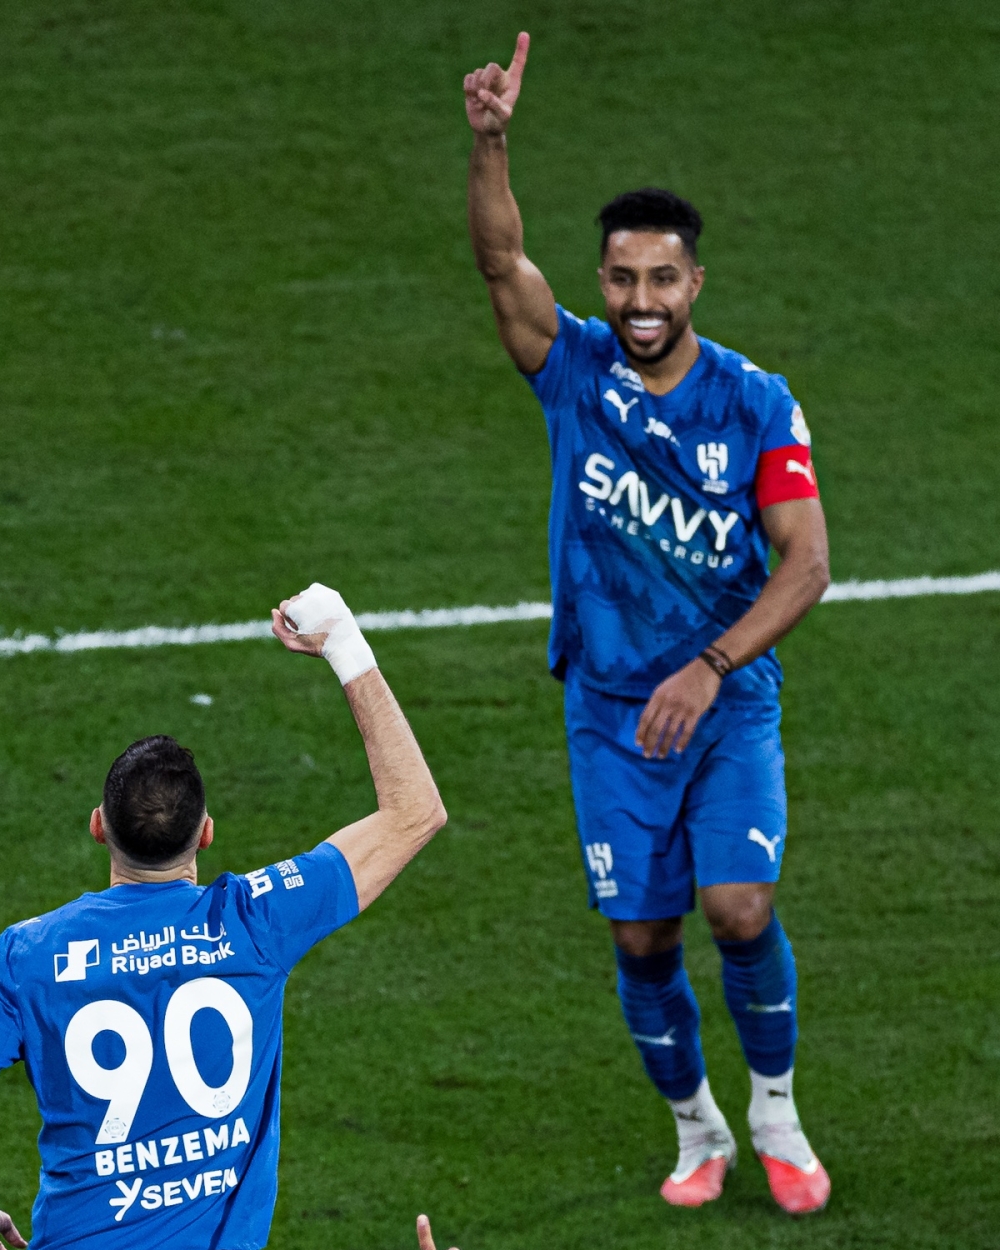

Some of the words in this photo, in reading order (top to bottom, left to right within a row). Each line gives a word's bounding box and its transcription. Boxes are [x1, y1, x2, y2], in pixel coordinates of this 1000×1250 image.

[578, 452, 739, 552] SAVVY
[659, 538, 734, 569] GROUP
[111, 926, 175, 954] الرياض
[111, 947, 177, 975] Riyad
[181, 941, 236, 965] Bank
[65, 977, 253, 1145] 90
[95, 1117, 251, 1176] BENZEMA
